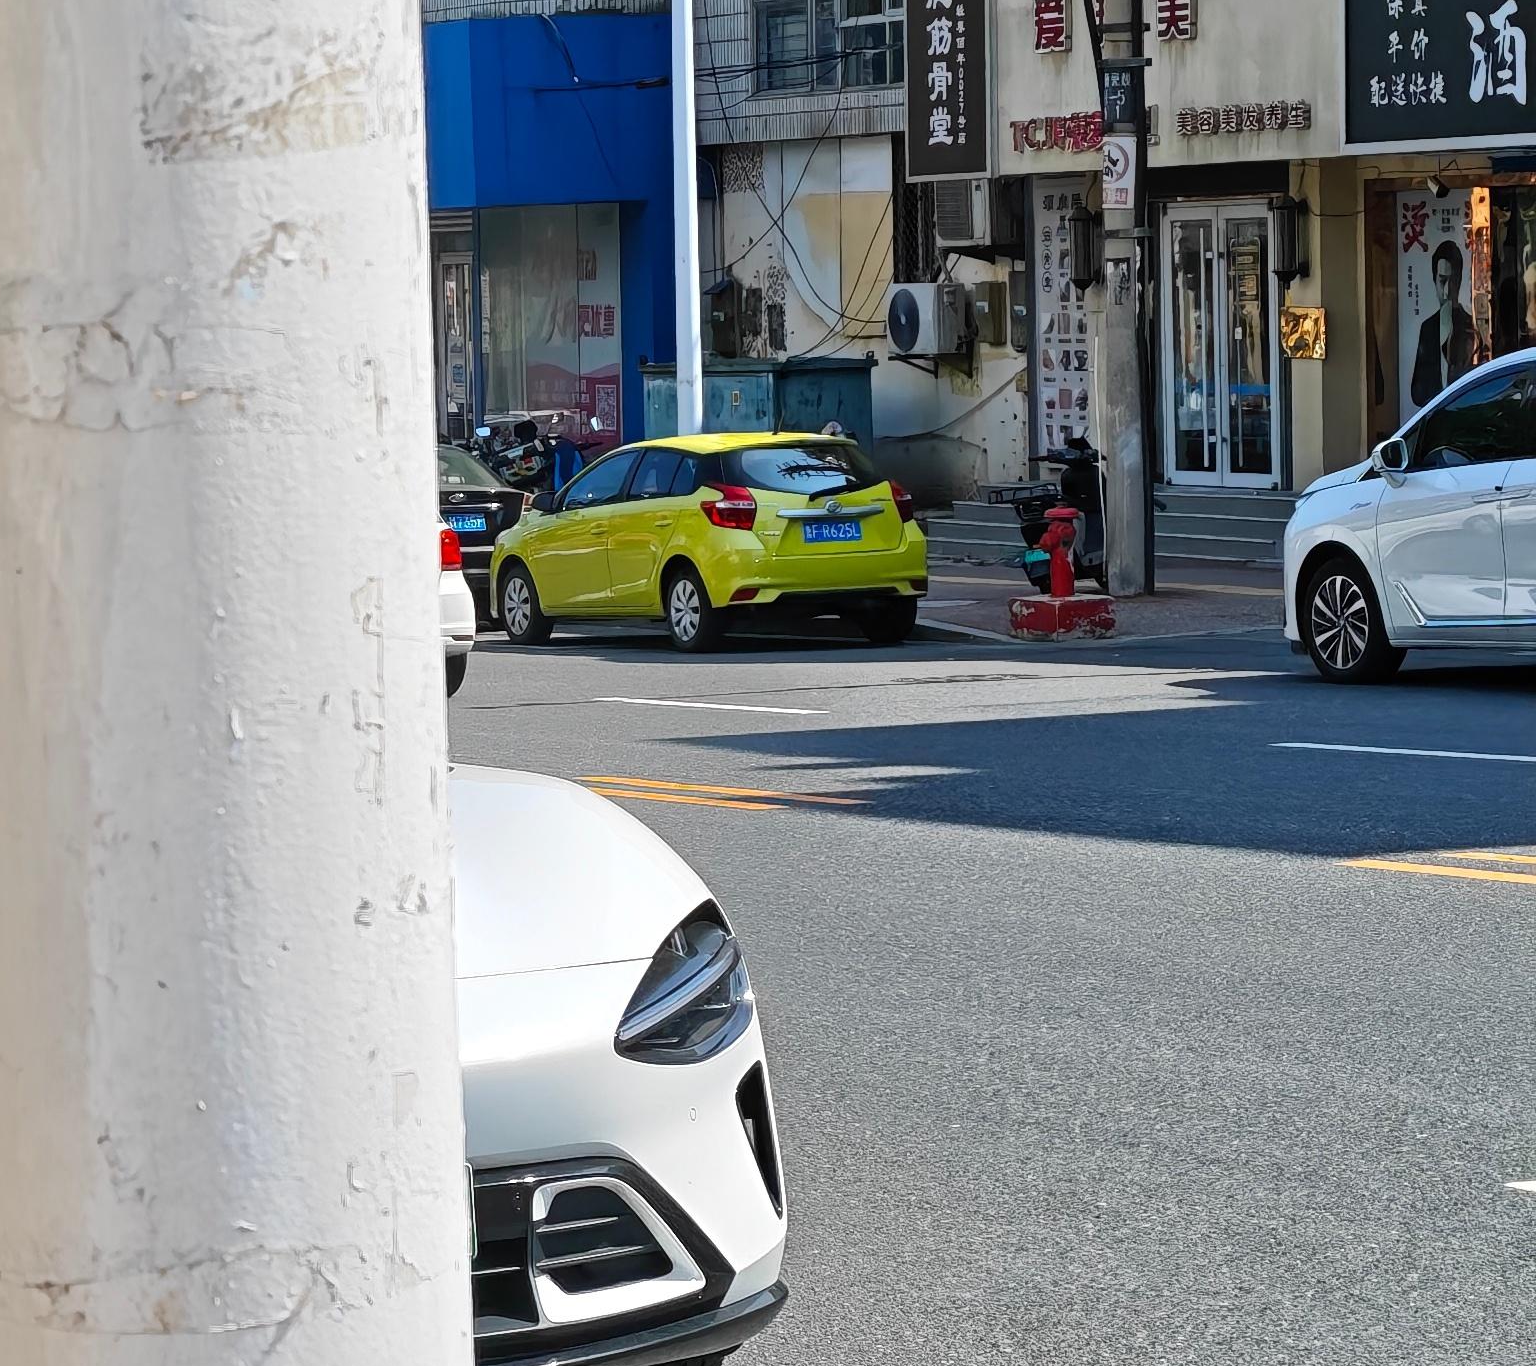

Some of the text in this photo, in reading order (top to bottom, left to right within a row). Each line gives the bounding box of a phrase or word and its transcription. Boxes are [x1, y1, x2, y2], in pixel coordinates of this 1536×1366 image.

[1387, 27, 1429, 64] 平价
[1368, 70, 1448, 108] 配送快捷
[1175, 99, 1307, 134] 美容美发养生
